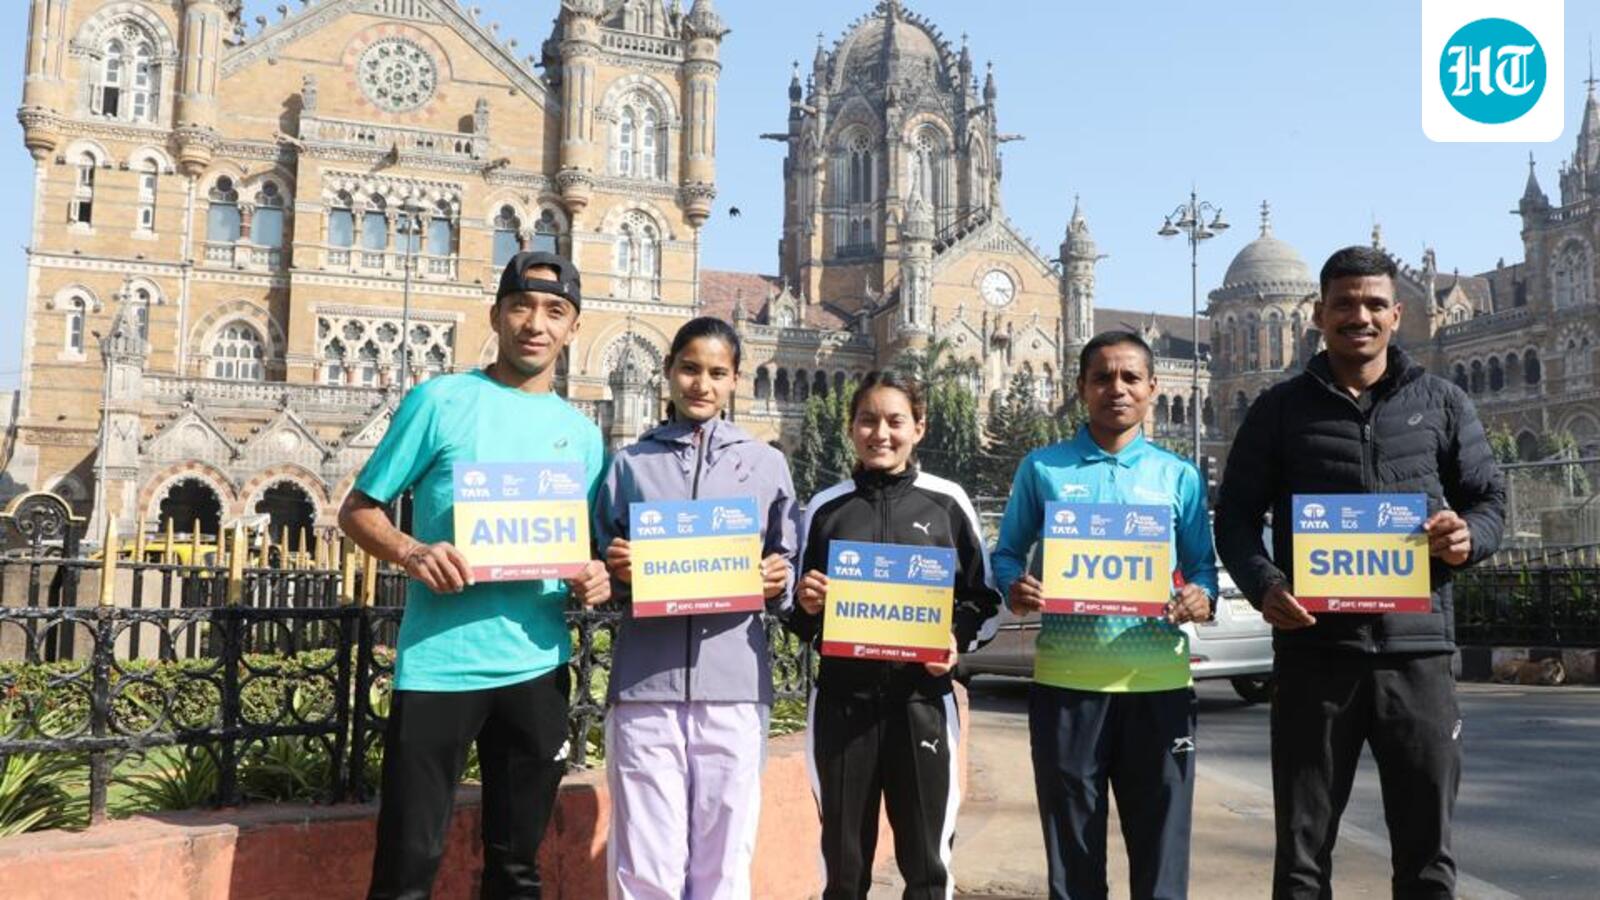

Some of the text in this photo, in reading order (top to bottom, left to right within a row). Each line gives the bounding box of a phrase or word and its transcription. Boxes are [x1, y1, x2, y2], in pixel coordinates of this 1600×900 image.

[460, 488, 491, 498] TATA
[470, 517, 576, 545] ANISH
[637, 526, 666, 536] TATA
[1051, 526, 1079, 534] TATA
[1299, 520, 1329, 529] TATA
[643, 556, 750, 575] BHAGIRATHI
[1062, 554, 1153, 581] JYOTI
[1309, 549, 1414, 576] SRINU
[834, 566, 862, 577] TATA
[836, 601, 942, 623] NIRMABEN
